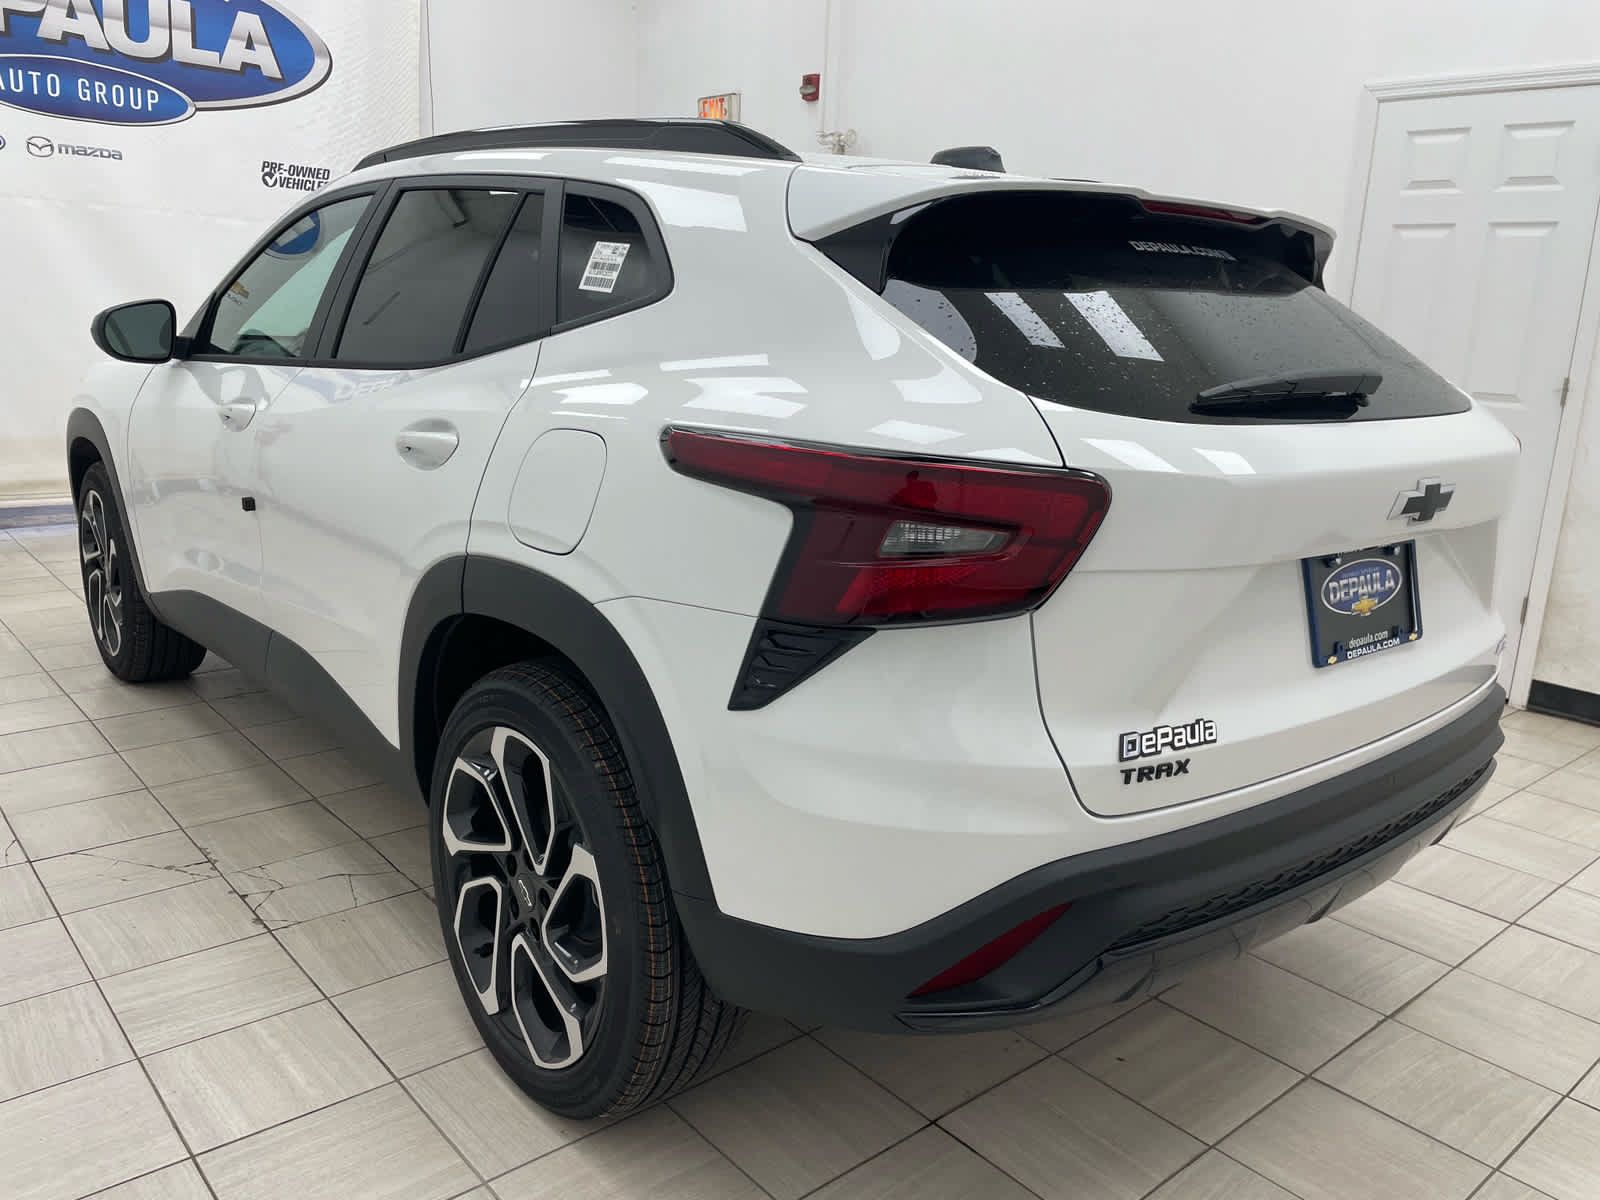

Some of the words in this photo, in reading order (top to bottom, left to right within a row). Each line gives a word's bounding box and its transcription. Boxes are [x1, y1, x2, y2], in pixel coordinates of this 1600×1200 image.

[78, 78, 160, 112] GROUP
[261, 160, 331, 181] PRE-OWNED
[279, 175, 329, 192] VEHICLE
[1328, 569, 1396, 605] DEPAULA
[1347, 637, 1400, 659] DEPAULA.COM
[1119, 718, 1217, 762] DePaula
[1120, 758, 1190, 784] TRAX
